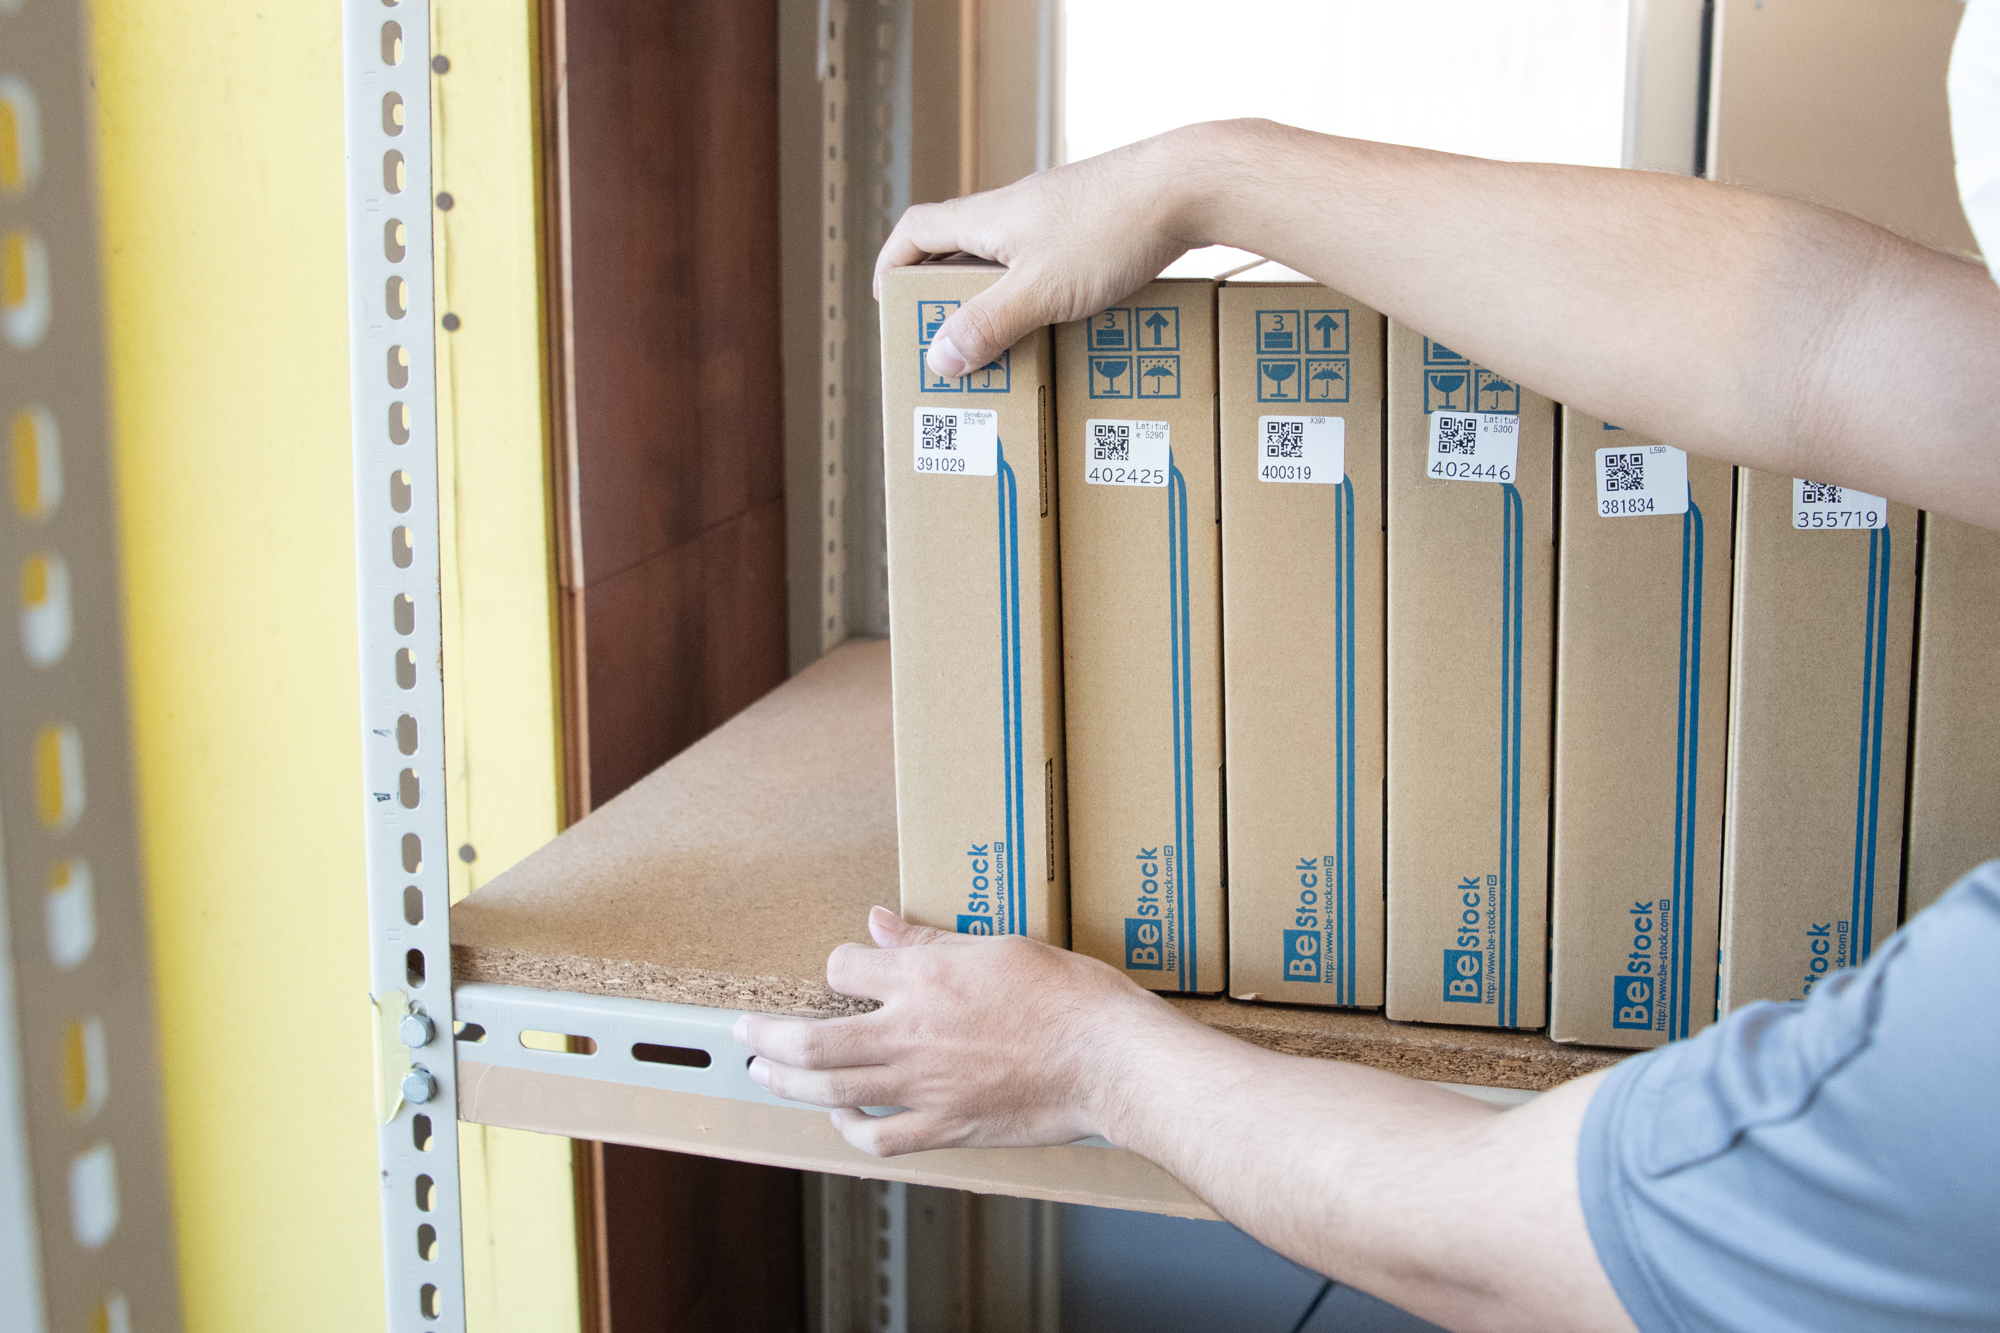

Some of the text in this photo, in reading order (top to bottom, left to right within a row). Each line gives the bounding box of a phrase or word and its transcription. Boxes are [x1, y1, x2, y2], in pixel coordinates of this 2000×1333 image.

[934, 305, 946, 322] 3
[1104, 312, 1116, 329] 3
[1272, 315, 1285, 331] 3
[963, 411, 993, 419] dynabook
[1310, 417, 1326, 425] X390
[1483, 414, 1519, 425] Latitud
[1135, 421, 1169, 430] Latitud
[1493, 424, 1513, 434] 5300
[1145, 431, 1164, 439] 5290
[1649, 446, 1667, 454] L590
[917, 456, 966, 472] 391029
[1431, 461, 1511, 480] 402446
[1089, 467, 1164, 484] 402425
[1262, 465, 1311, 480] 400319
[1602, 497, 1655, 514] 381834
[1797, 510, 1878, 528] 355719
[1164, 857, 1177, 972] http://www.be-stock.com
[1323, 867, 1334, 984] http://www.be-stock.com
[1484, 887, 1497, 1005] http://www.be-stock.com
[1655, 912, 1669, 1032] http://www.be-stock.com
